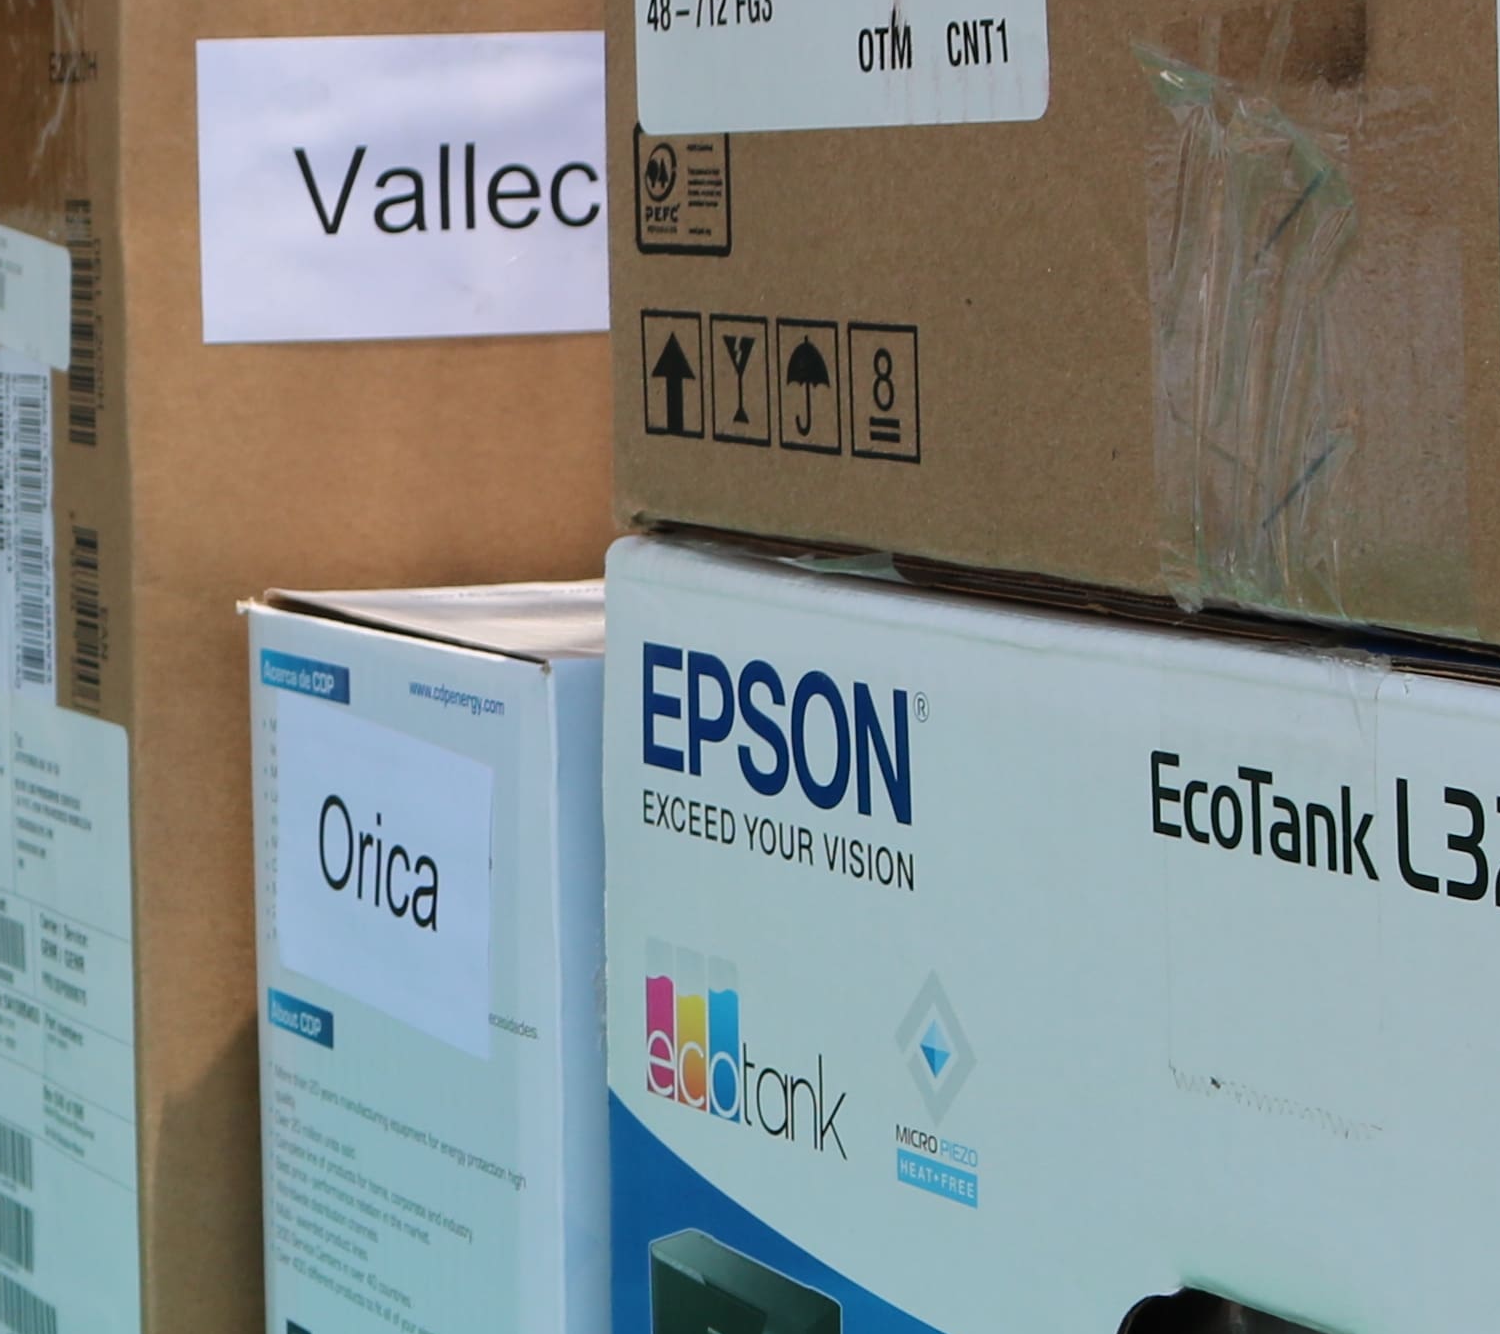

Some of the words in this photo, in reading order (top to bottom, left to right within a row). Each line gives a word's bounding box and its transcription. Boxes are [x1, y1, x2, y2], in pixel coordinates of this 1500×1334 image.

[858, 25, 913, 73] OTM
[946, 18, 1009, 68] CNT1
[293, 142, 601, 235] Vallec
[409, 679, 505, 717] www.cdpenergy.com
[643, 640, 913, 826] EPSON
[317, 794, 440, 932] Orica
[642, 788, 736, 846] EXCEED
[743, 812, 815, 867] YOUR
[823, 831, 915, 892] VISION
[1150, 750, 1380, 882] EcoTank
[895, 1122, 939, 1156] MICRO
[940, 1138, 978, 1169] PIEZO
